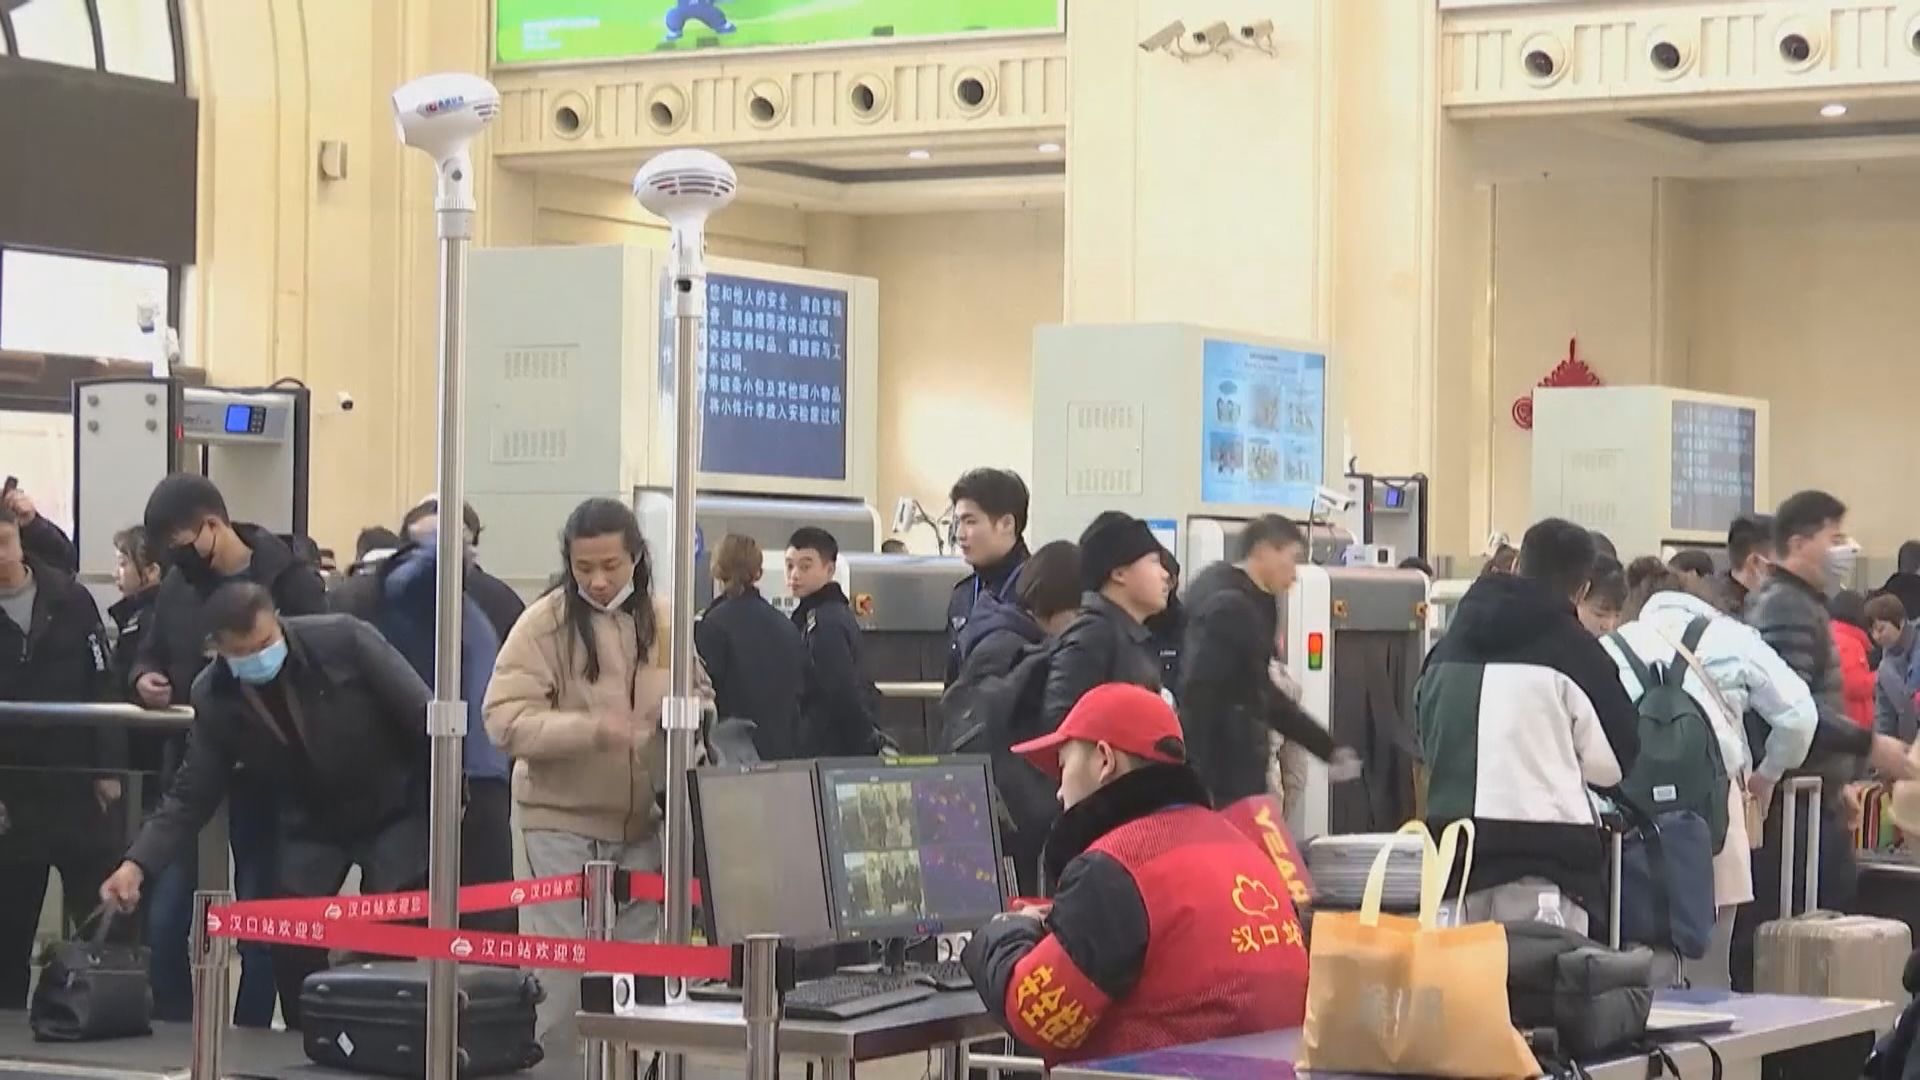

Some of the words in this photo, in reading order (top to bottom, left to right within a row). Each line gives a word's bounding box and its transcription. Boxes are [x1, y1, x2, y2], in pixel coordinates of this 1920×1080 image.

[347, 896, 423, 917] 汉口站欢迎您
[229, 913, 325, 941] 汉口站欢迎您
[481, 936, 587, 964] 汉口站欢迎您
